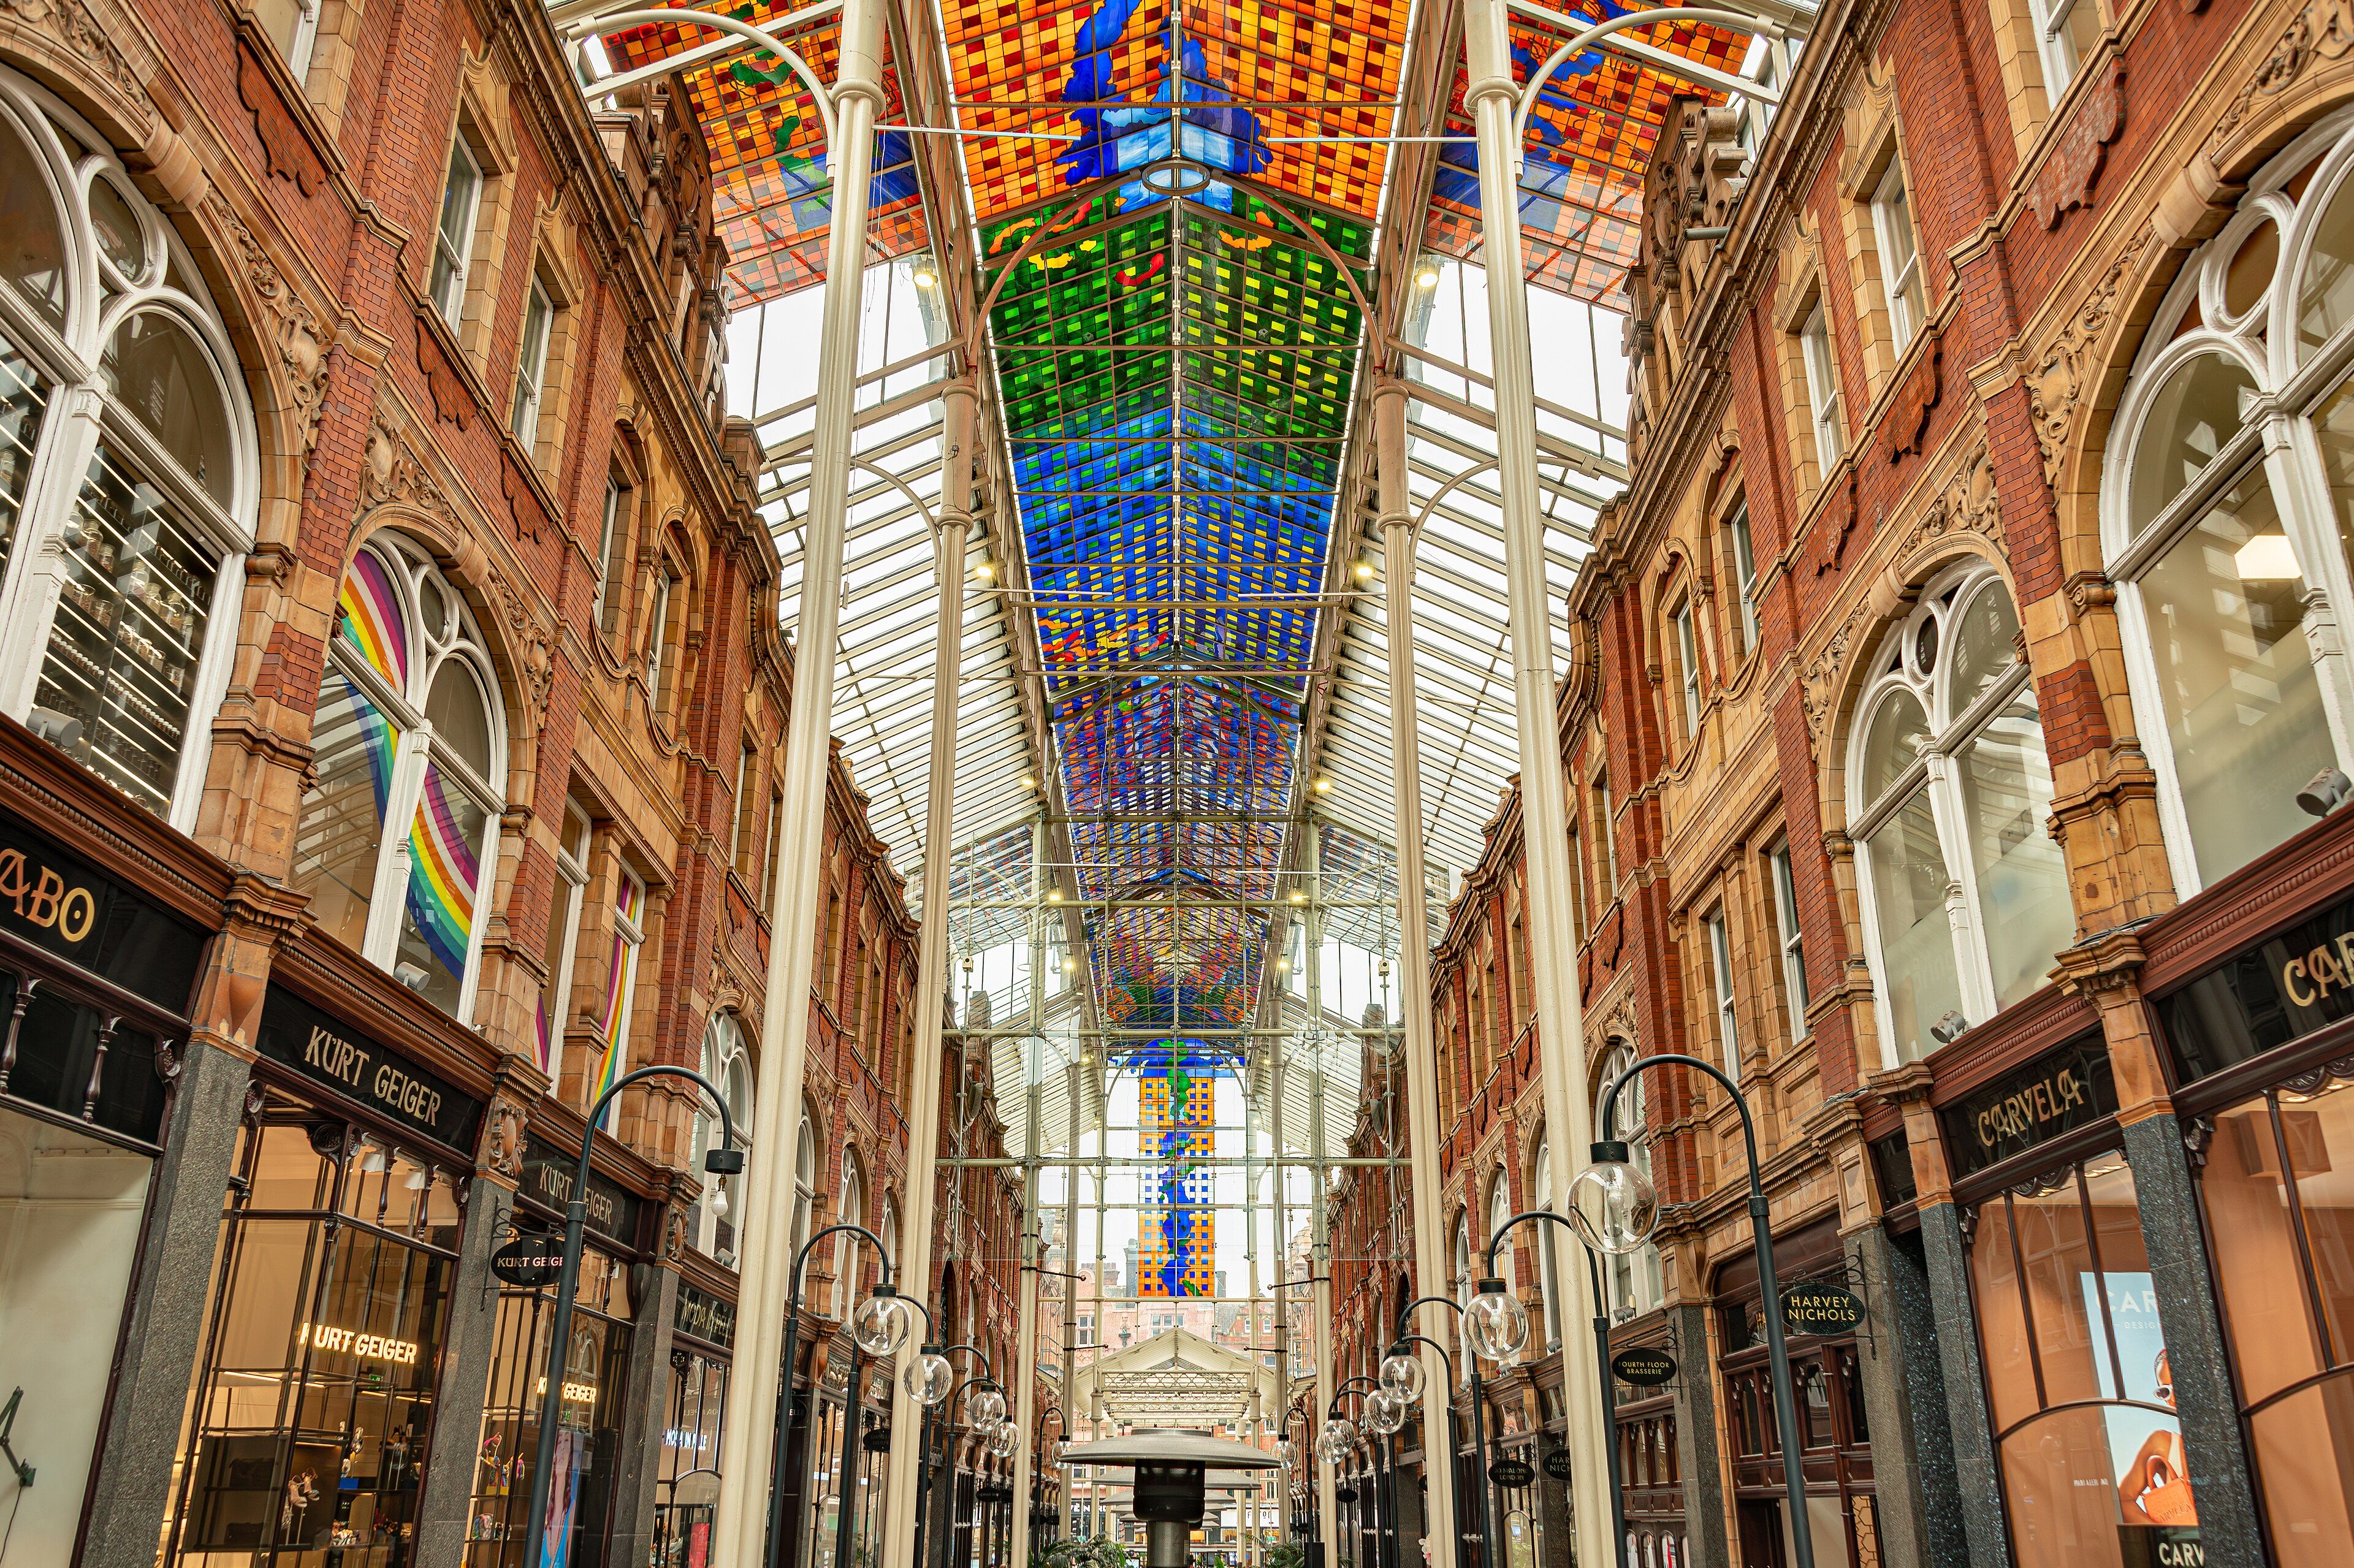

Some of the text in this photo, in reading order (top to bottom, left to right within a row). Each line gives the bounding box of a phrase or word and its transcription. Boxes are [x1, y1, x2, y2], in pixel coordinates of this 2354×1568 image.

[305, 1025, 441, 1127] KURT GEIGER
[1978, 1068, 2084, 1147] CARVELA
[539, 1162, 613, 1225] KURT EIGER
[497, 1257, 563, 1268] KURT GEIGE
[681, 1298, 706, 1329] MODA
[1790, 1295, 1849, 1308] HARVEY
[1788, 1308, 1856, 1322] NICHOLS
[354, 1333, 418, 1364] GEIGER
[563, 1382, 597, 1404] GEIGER
[691, 1433, 707, 1451] PLE
[2158, 1542, 2206, 1567] CARV
